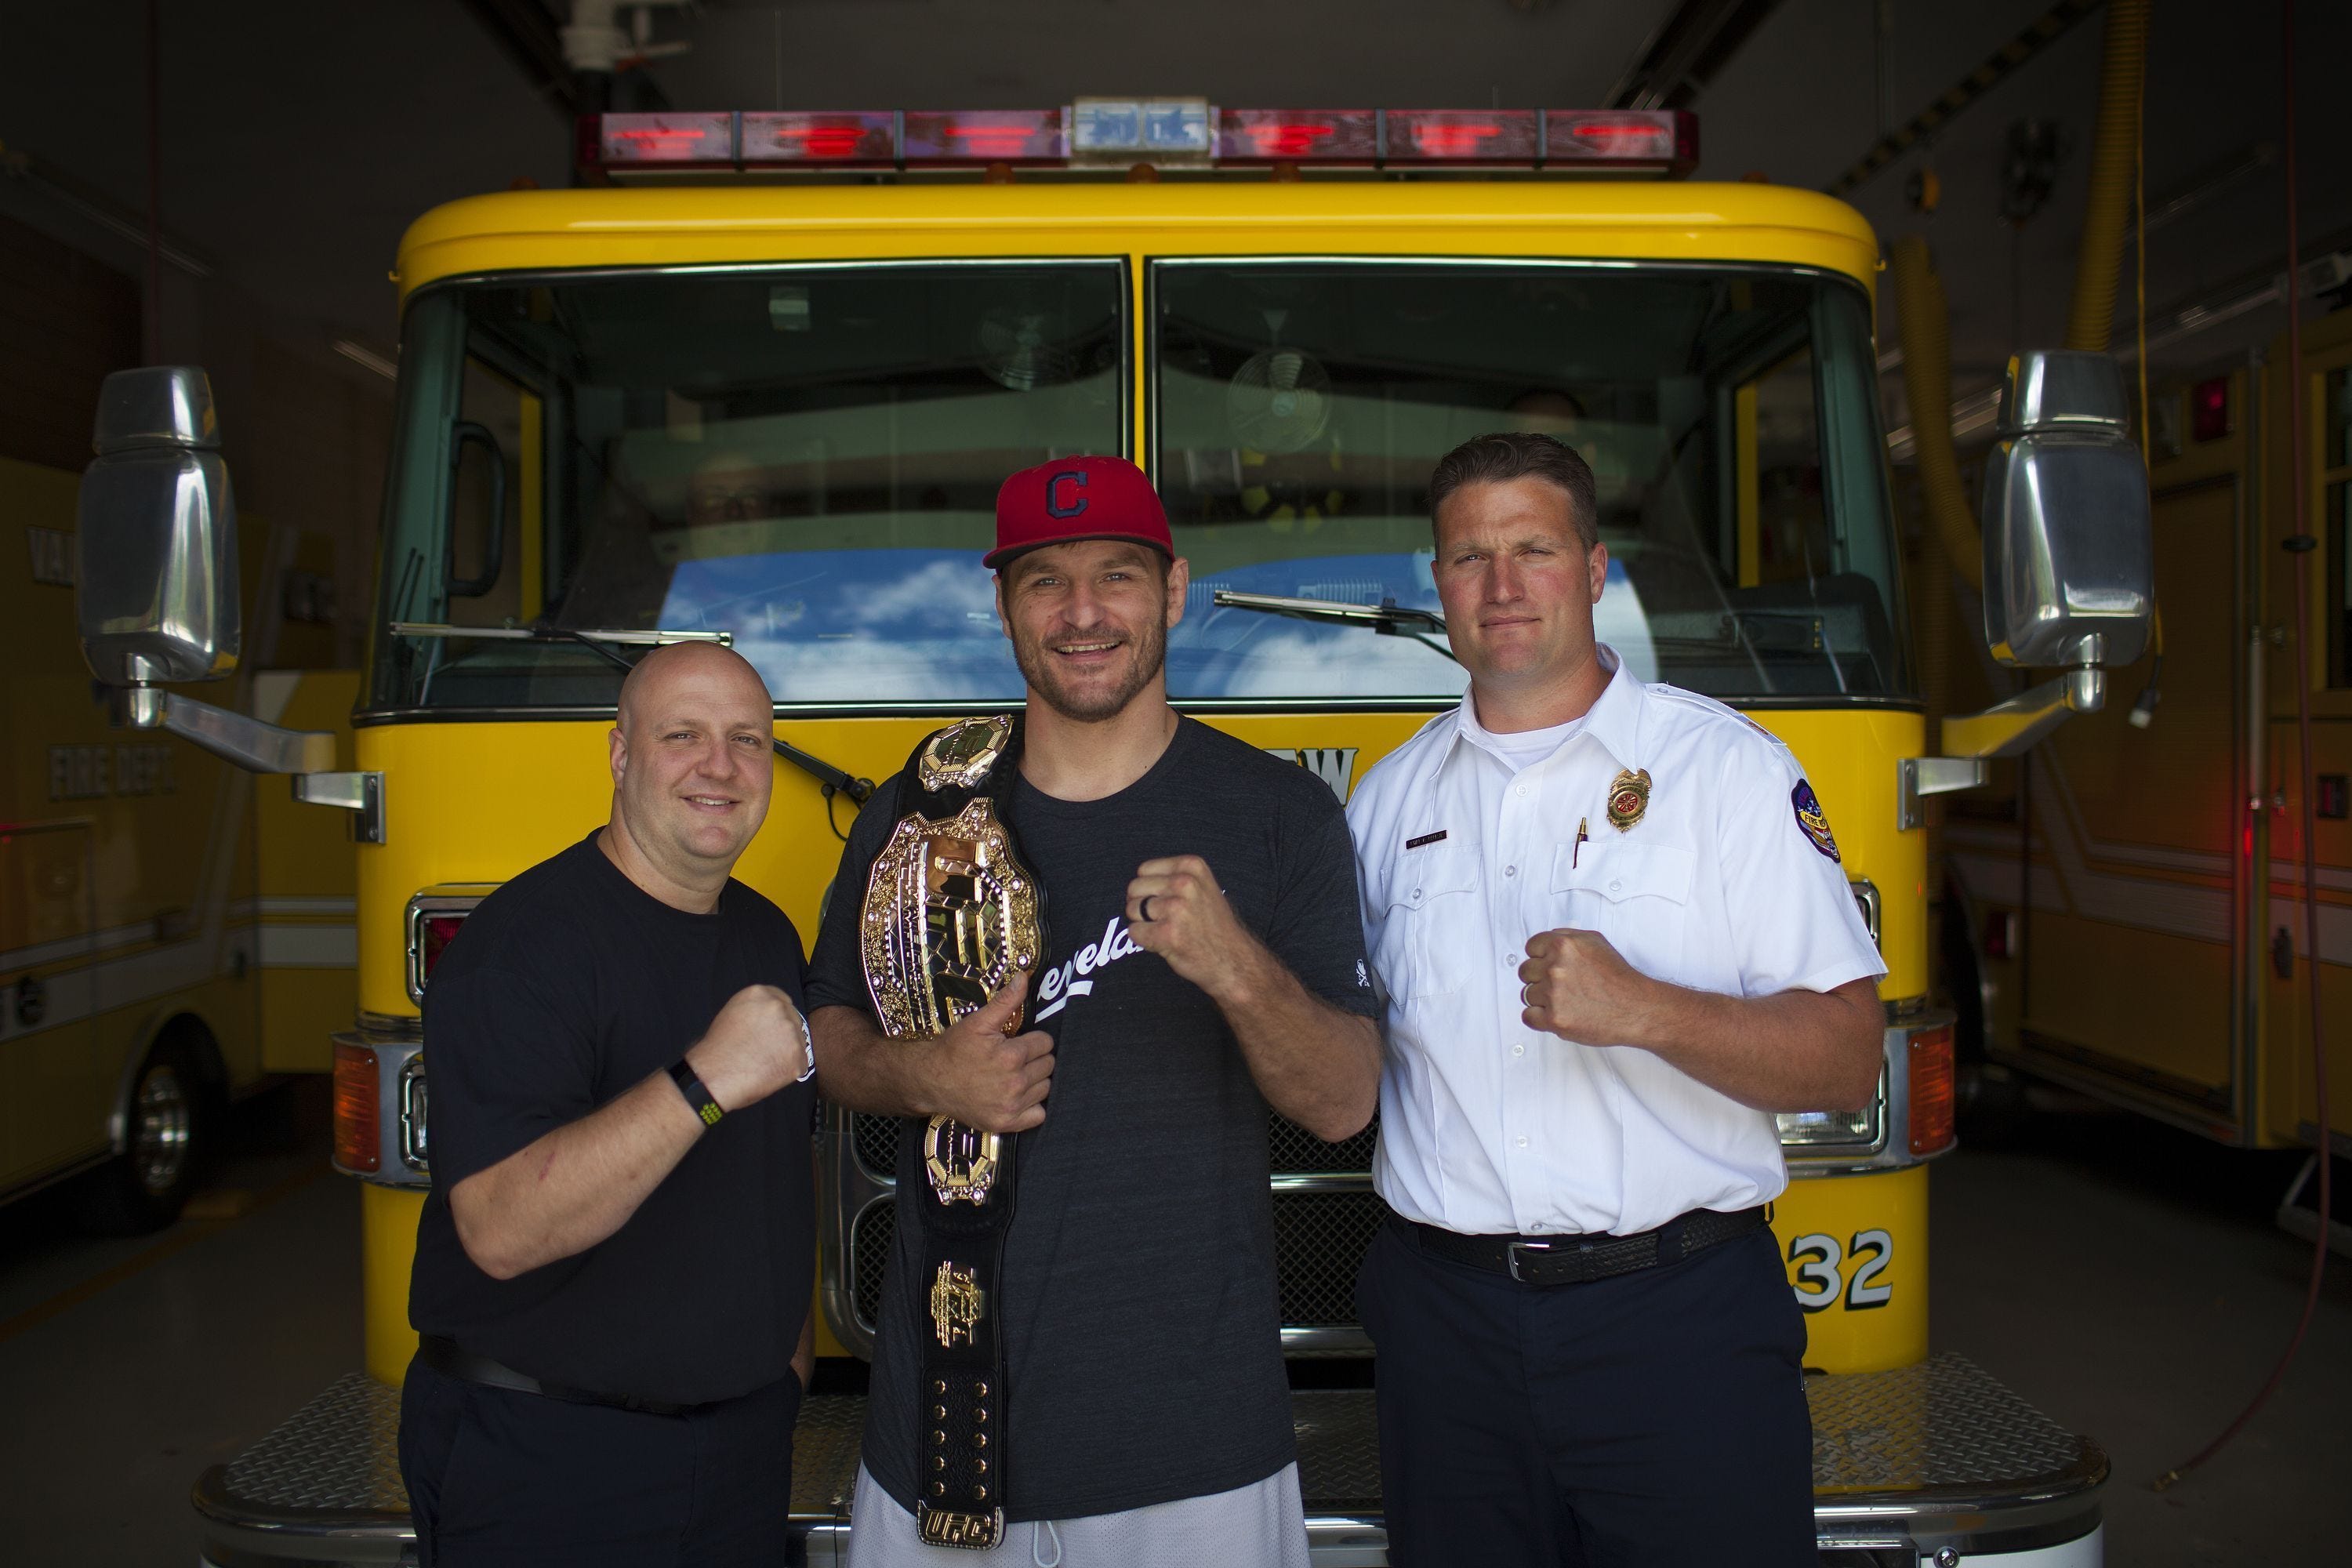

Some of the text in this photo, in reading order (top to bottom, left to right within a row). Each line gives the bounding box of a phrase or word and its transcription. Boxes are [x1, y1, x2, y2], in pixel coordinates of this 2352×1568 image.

[1046, 471, 1088, 519] C
[49, 746, 108, 800] FIRE
[1263, 749, 1359, 808] W
[1788, 1228, 1893, 1313] 32
[926, 1512, 990, 1543] UFC
